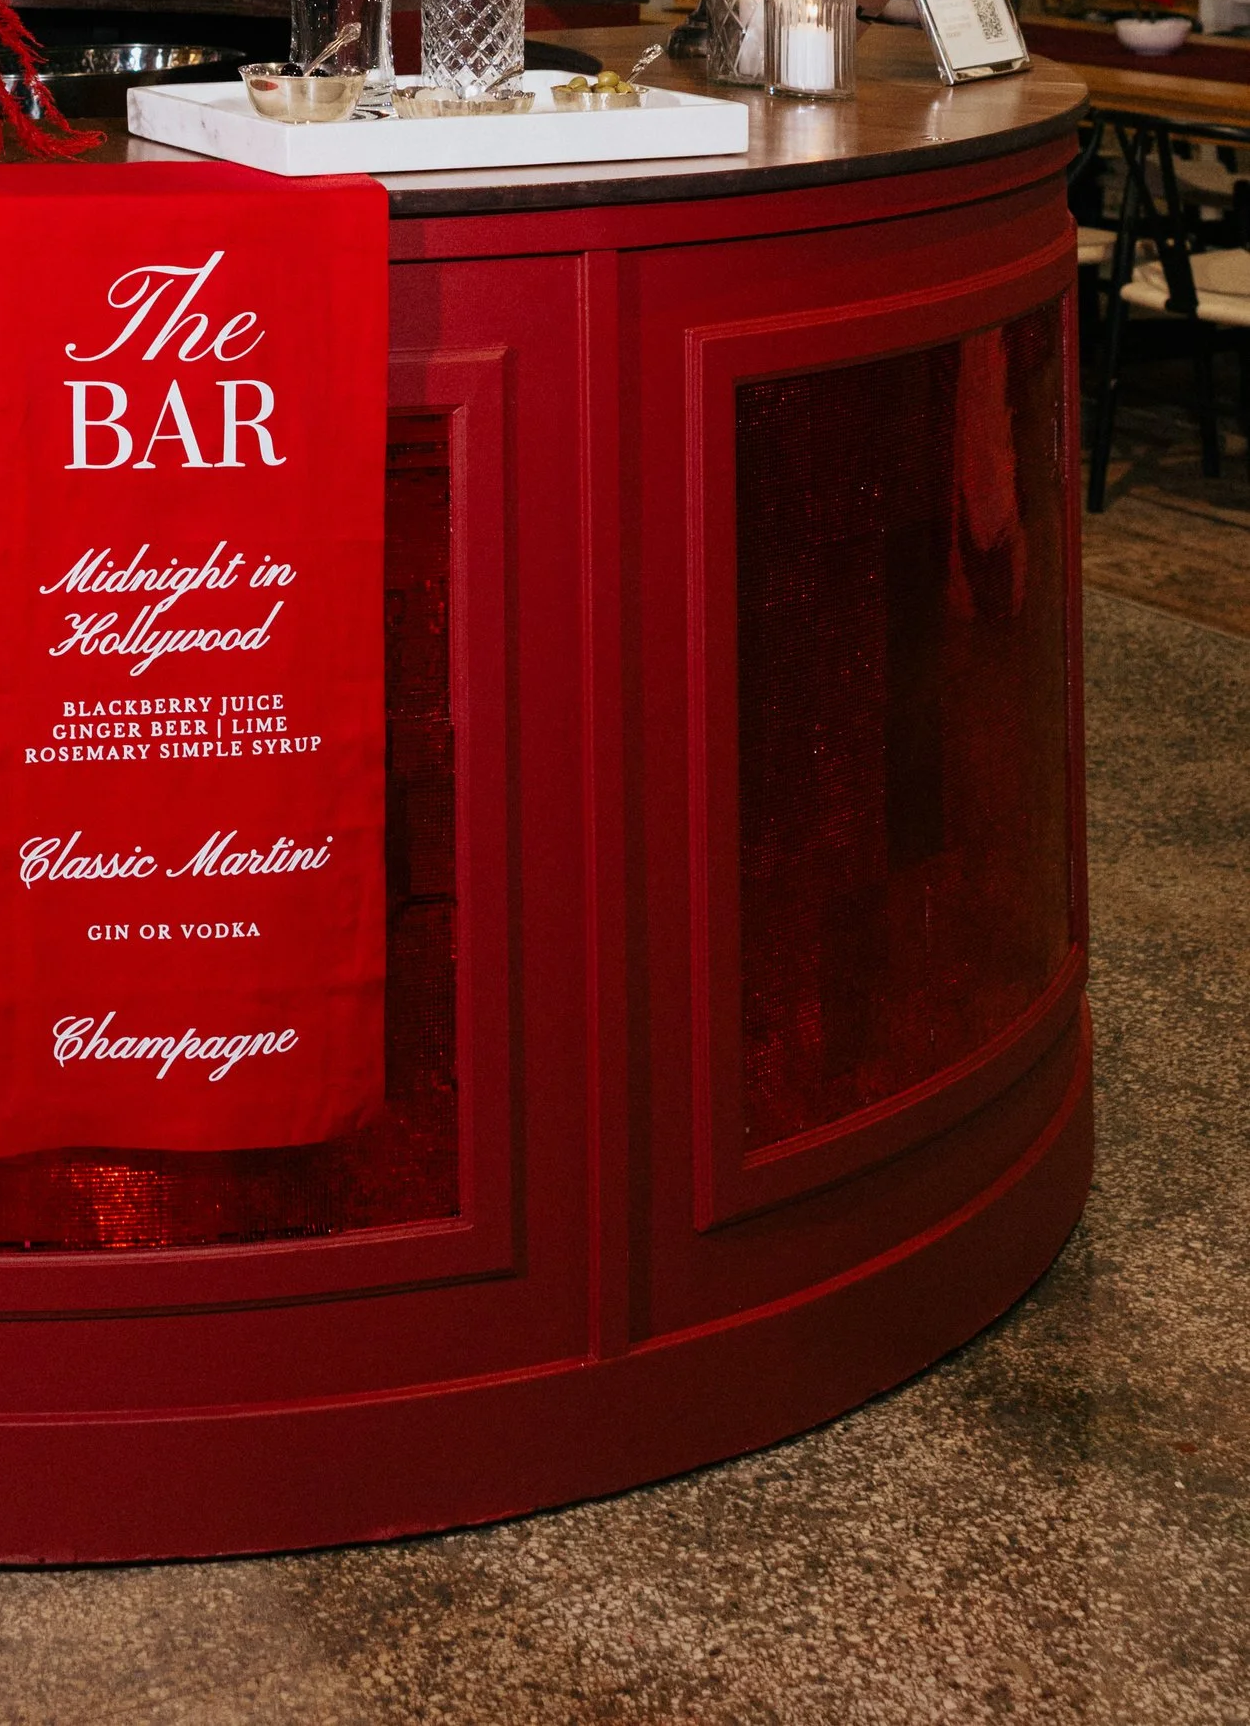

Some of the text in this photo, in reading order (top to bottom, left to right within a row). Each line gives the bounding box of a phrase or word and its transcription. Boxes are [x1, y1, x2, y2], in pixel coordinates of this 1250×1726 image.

[64, 250, 266, 362] The
[63, 379, 287, 470] BAR
[40, 540, 297, 614] Midnight in
[49, 601, 285, 677] Hollywood
[52, 722, 142, 740] GINGER
[151, 719, 209, 737] BEER
[232, 715, 288, 735] LIME
[63, 694, 284, 718] BLACKBERRY JUICE
[25, 735, 322, 764] ROSEMARY SIMPLE SYRUP
[19, 829, 334, 890] Classic Martini
[87, 921, 261, 941] GIN OR VODKA
[52, 1010, 300, 1082] Champagne
